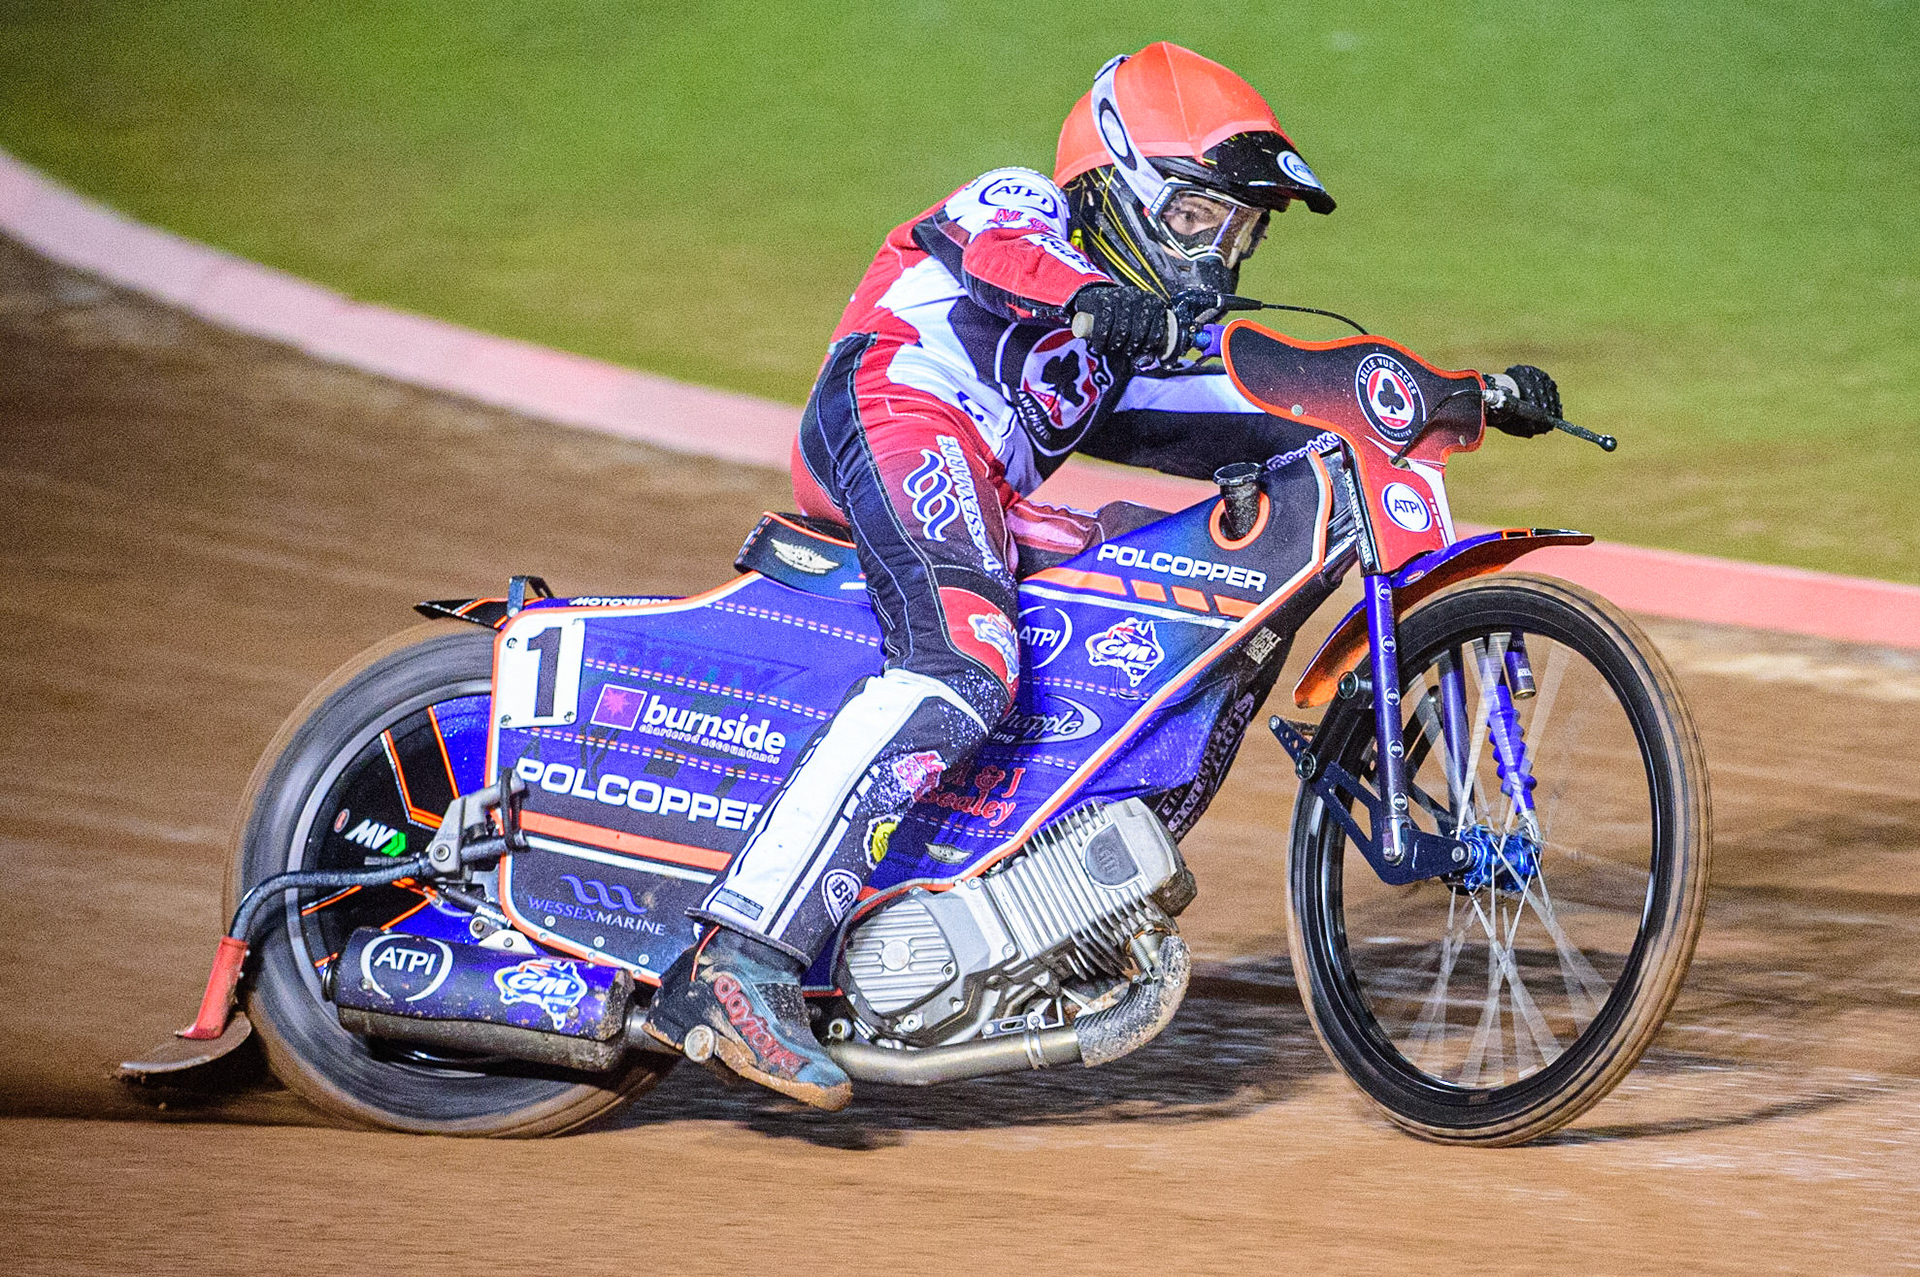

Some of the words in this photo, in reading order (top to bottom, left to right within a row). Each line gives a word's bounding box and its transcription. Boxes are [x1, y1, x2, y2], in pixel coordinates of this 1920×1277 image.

[991, 185, 1048, 205] ATPI
[1359, 358, 1377, 386] BELLE
[1377, 357, 1394, 371] VUE
[1397, 368, 1417, 395] ACES
[1016, 388, 1051, 441] ANCHESTE
[1394, 498, 1422, 515] ATPI
[1097, 543, 1268, 592] POLCOPPER
[1019, 625, 1059, 647] ATPI
[1097, 637, 1152, 662] GM
[527, 627, 562, 718] 1
[643, 695, 786, 754] burnside
[1000, 704, 1082, 738] happle
[639, 724, 699, 744] chartered
[701, 736, 780, 765] accountants
[1001, 767, 1026, 798] J
[345, 819, 399, 850] MV
[374, 948, 437, 975] ATPI
[507, 971, 571, 996] GM
